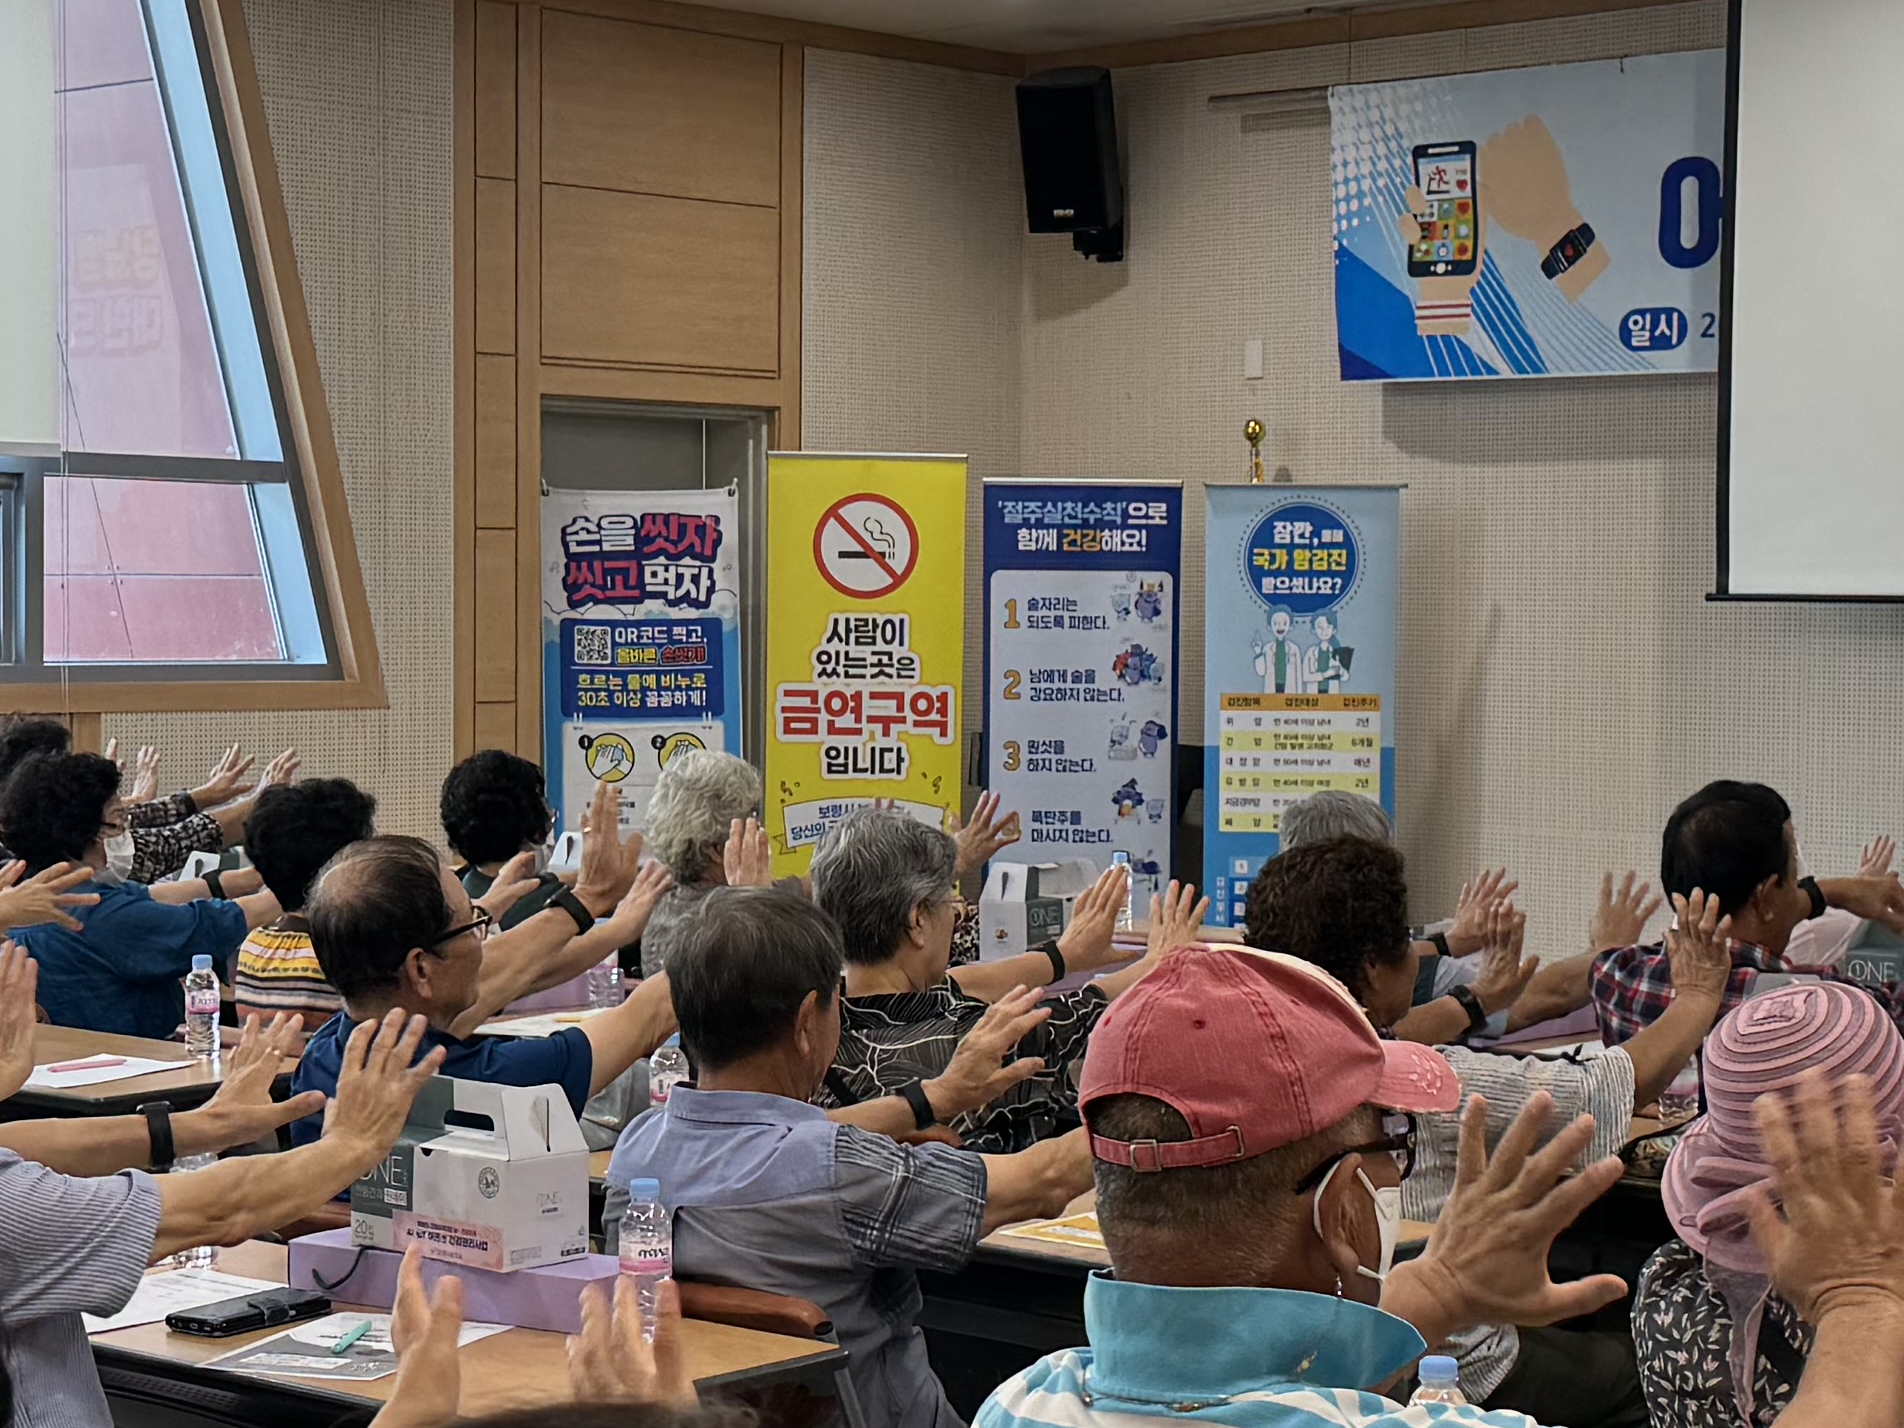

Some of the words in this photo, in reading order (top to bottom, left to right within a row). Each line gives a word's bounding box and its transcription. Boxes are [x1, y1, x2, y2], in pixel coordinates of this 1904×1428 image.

[1627, 312, 1679, 347] 일시
[566, 516, 636, 554] 손을
[640, 513, 718, 556] 씻자
[1017, 528, 1057, 552] 함께
[1062, 528, 1147, 552] 건강해요!
[1273, 521, 1319, 547] 잠깐,
[1253, 548, 1288, 570] 국가
[1293, 548, 1347, 571] 암검진
[567, 560, 641, 601] 씻고
[644, 563, 711, 602] 먹자
[1004, 598, 1021, 629] 1
[1027, 597, 1078, 612] 술자리는
[615, 626, 668, 643] QR코드
[826, 617, 905, 647] 사람이
[1068, 615, 1110, 630] 피한다.
[816, 650, 916, 679] 있는곳은
[1029, 669, 1068, 684] 남에게
[577, 674, 623, 690] 흐르는
[661, 673, 707, 689] 비누로
[1003, 669, 1021, 700] 2
[578, 691, 610, 706] 30초
[614, 691, 641, 707] 이상
[645, 690, 706, 707] 꼼꼼하게!
[1030, 688, 1080, 702] 강요하지
[781, 689, 948, 737] 금연구역
[825, 746, 905, 775] 입니다
[1003, 740, 1021, 771] 3
[1027, 758, 1052, 772] 하지
[1031, 829, 1069, 843] 마시지
